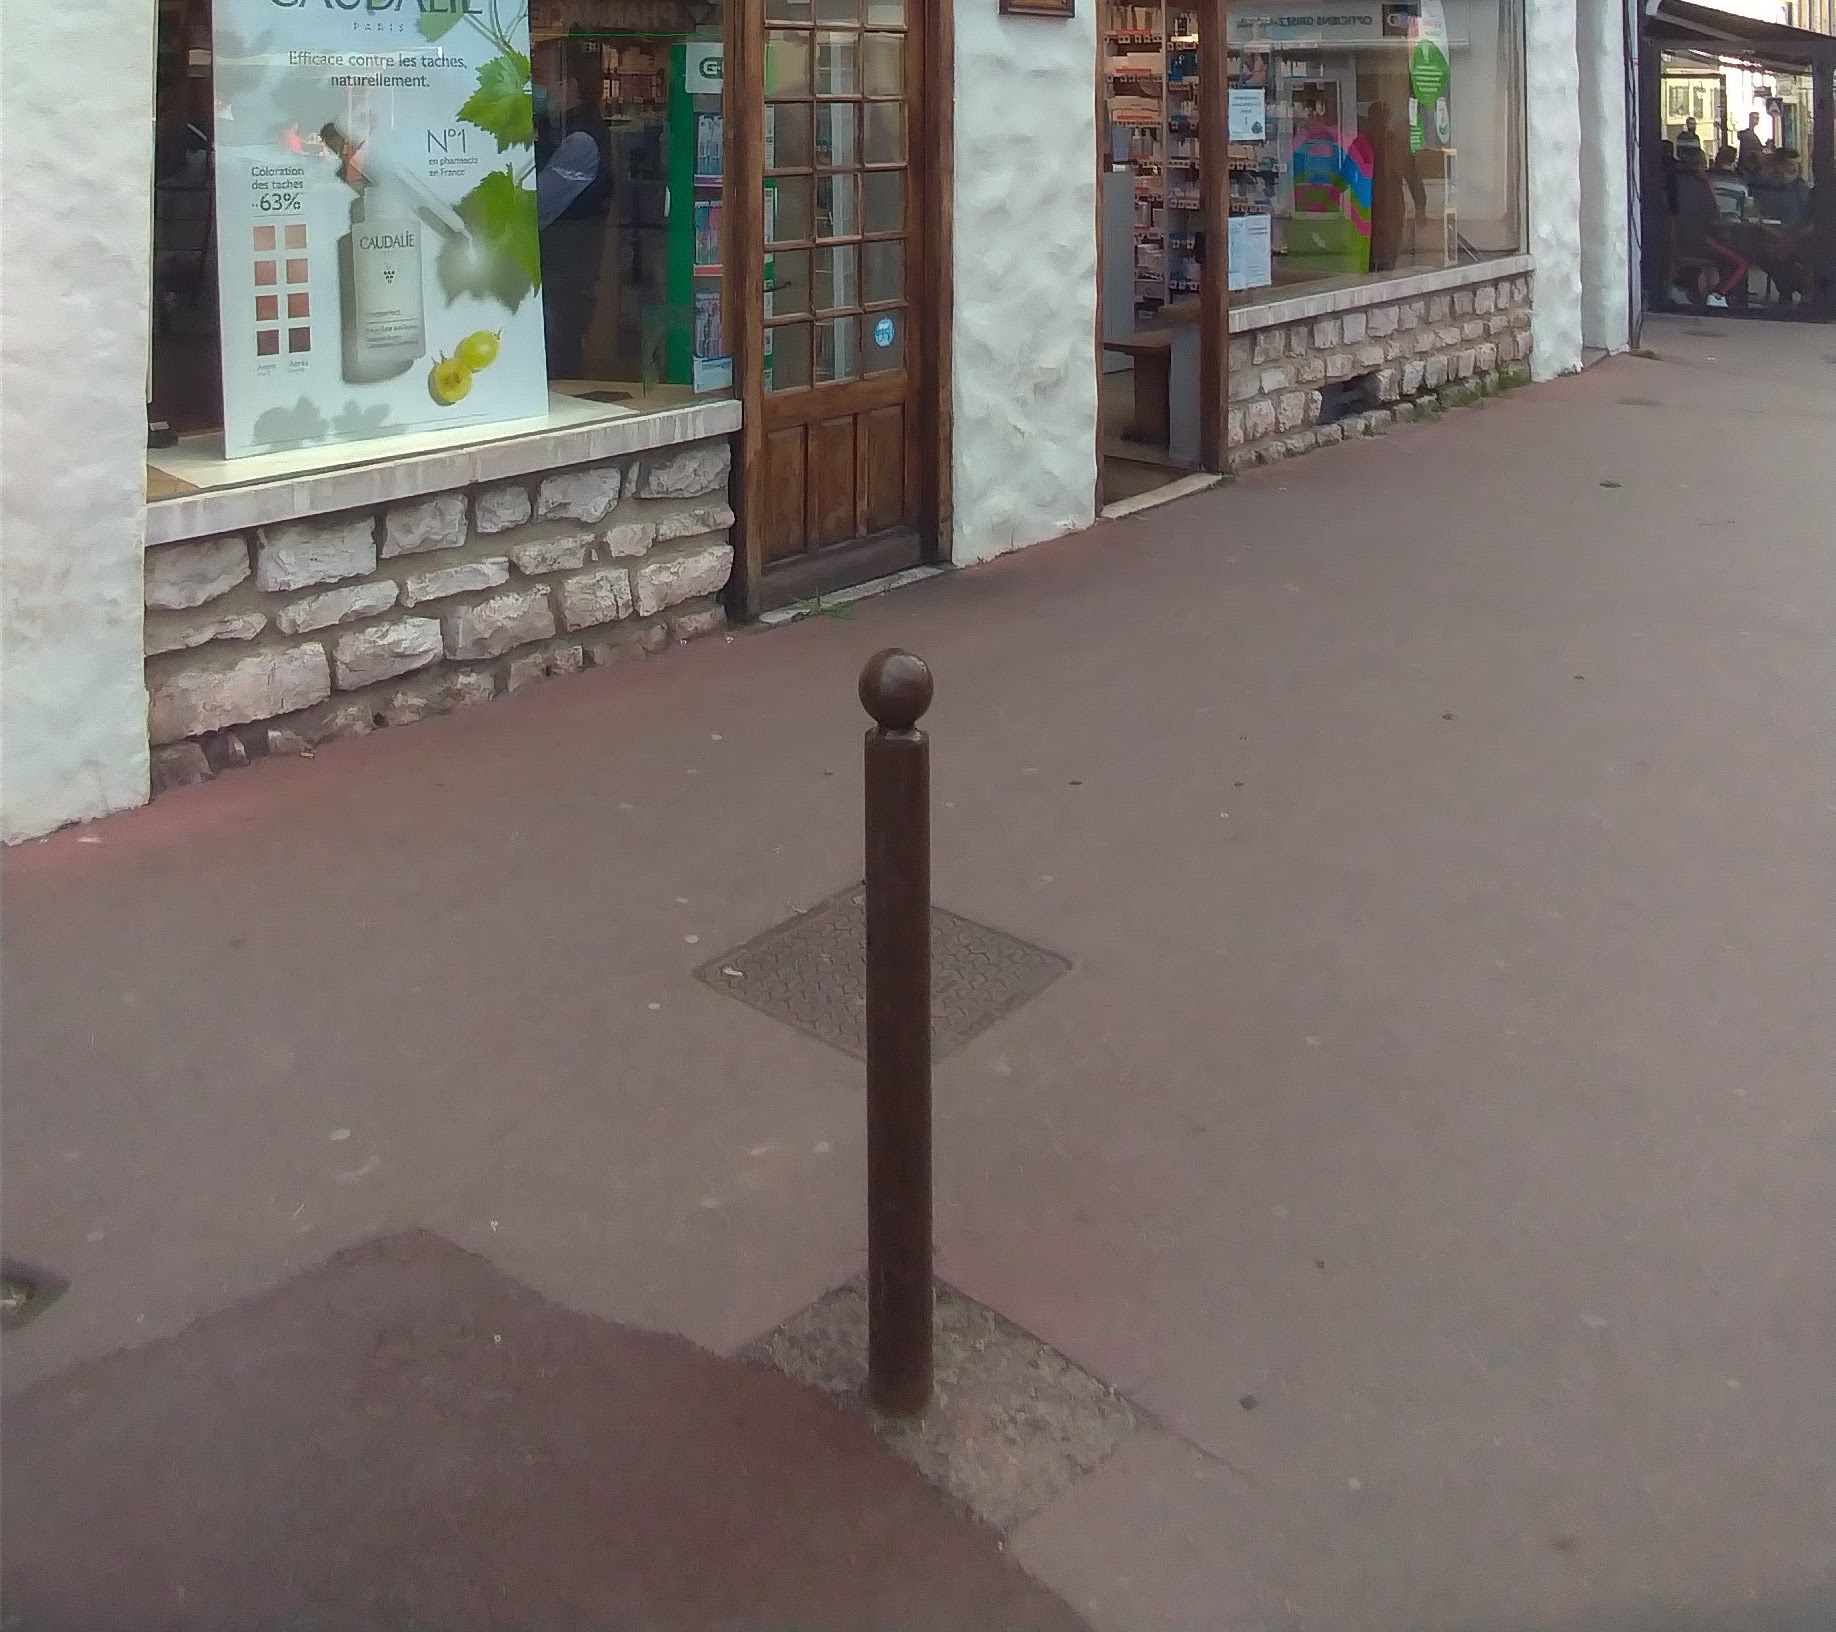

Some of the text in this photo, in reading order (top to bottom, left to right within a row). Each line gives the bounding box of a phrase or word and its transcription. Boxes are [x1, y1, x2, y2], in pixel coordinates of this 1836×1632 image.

[289, 50, 467, 69] Efficace contre les taches,
[330, 72, 431, 89] naturellement.
[251, 166, 305, 177] Coloration
[251, 179, 304, 190] des taches
